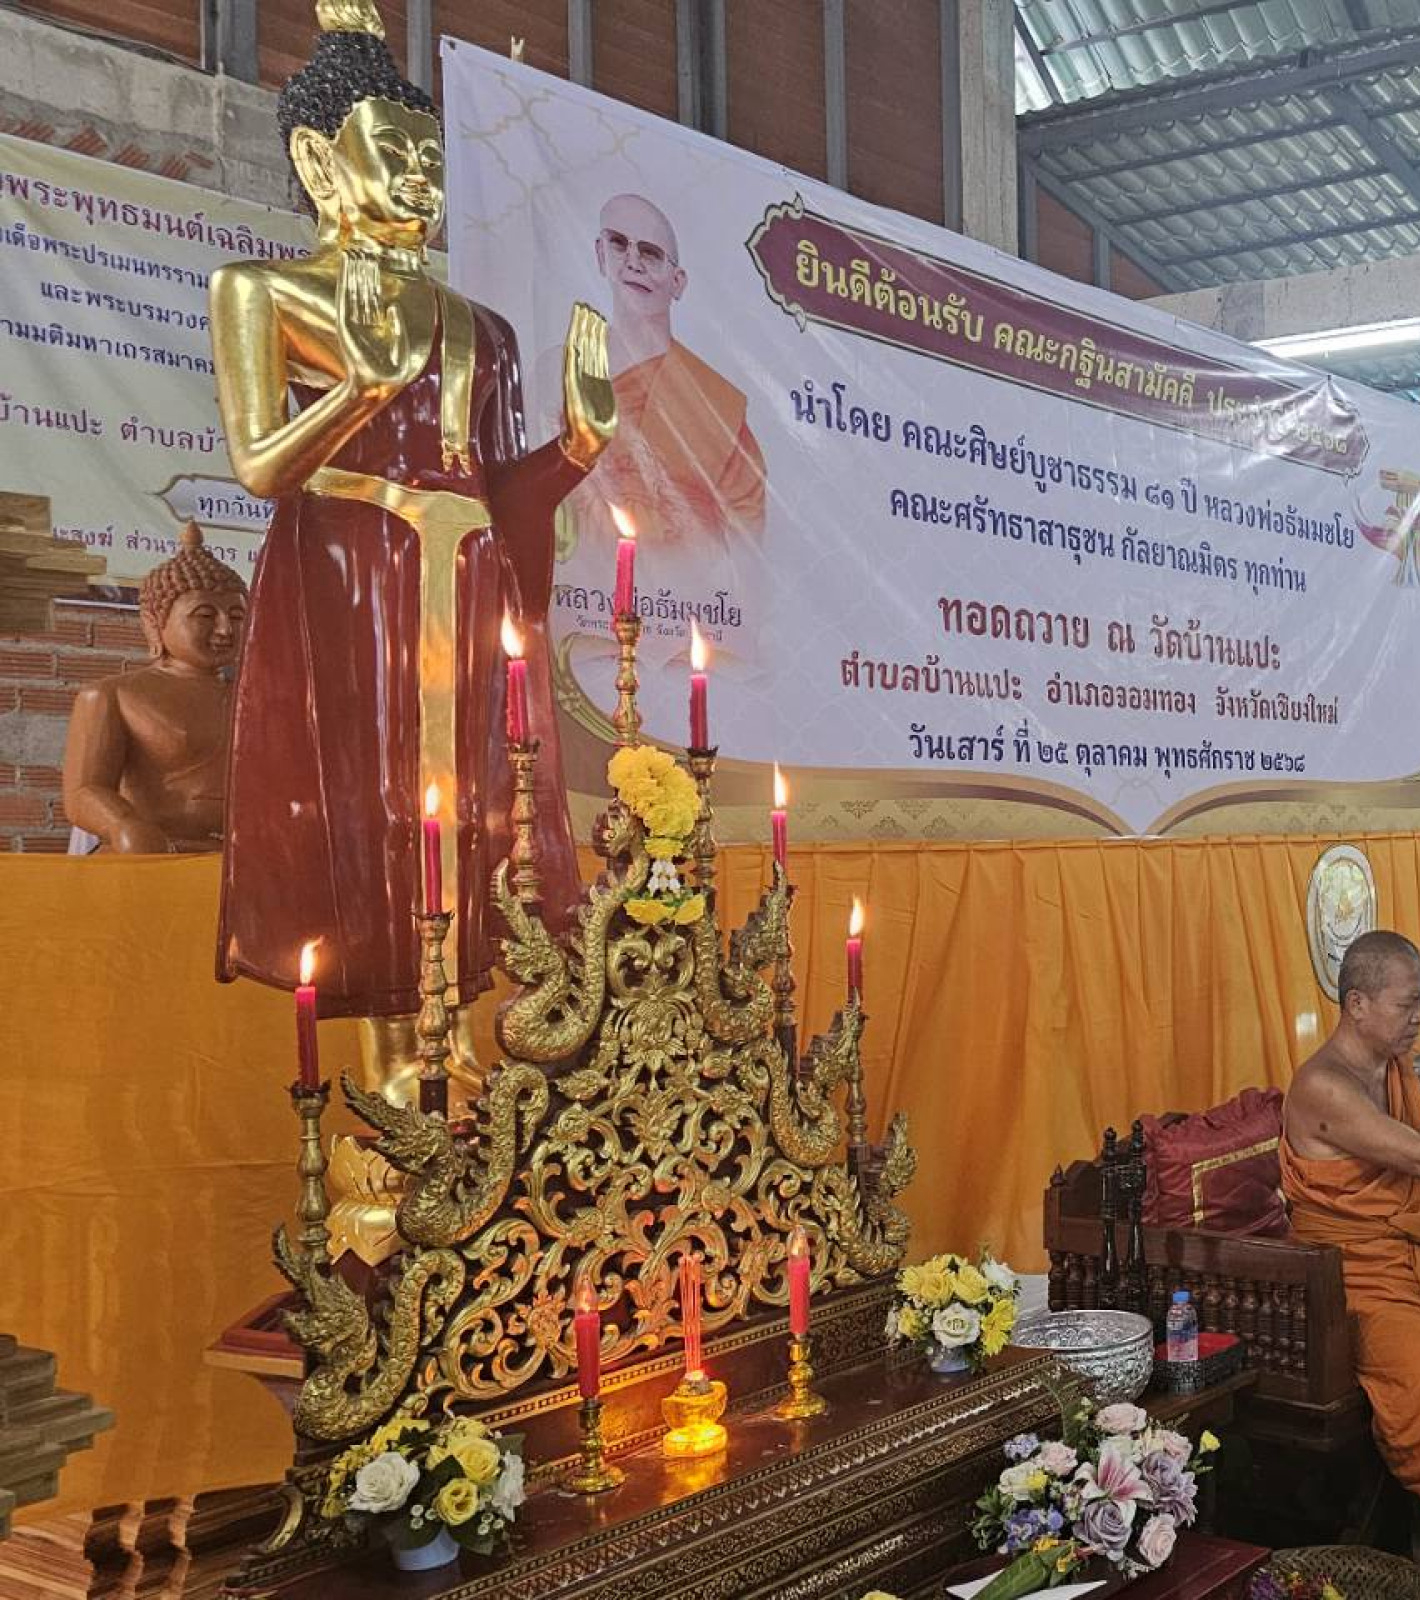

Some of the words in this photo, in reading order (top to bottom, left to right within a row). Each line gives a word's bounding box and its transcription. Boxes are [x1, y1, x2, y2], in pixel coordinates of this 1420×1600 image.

[796, 239, 985, 343] ยินดีต้อนรับ
[993, 322, 1197, 408] คณะกฐินสามัคคี
[790, 379, 891, 443] นำโดย
[902, 419, 1137, 503] คณะศิษย์บูชาธรรม
[1145, 483, 1175, 510] ๘๑
[1181, 476, 1198, 514] ปี
[1204, 493, 1355, 549] หลวงพ่อธัมมชโย
[890, 489, 1115, 566] คณะศรัทธาสาธุชน
[1121, 526, 1238, 581] กัลยาณมิตร
[1244, 556, 1307, 596] ทุกท่าน
[938, 596, 1090, 649] ทอดถวาย
[1107, 620, 1136, 654] ณ
[1150, 613, 1281, 671] วัดบ้านแปะ
[840, 651, 1023, 701] ตำบลบ้านแปะ
[1046, 671, 1197, 715] อำเภอจอมทอง
[1215, 685, 1339, 725] จังหวัดเชียงใหม่
[908, 722, 1004, 762] วันเสาร์
[1013, 718, 1031, 763] ที่
[1037, 740, 1069, 764] ๒๕
[1076, 742, 1147, 778] ตุลาคม
[1154, 739, 1256, 779] พุทธศักราช
[1261, 752, 1306, 773] ๒๕๖๘
